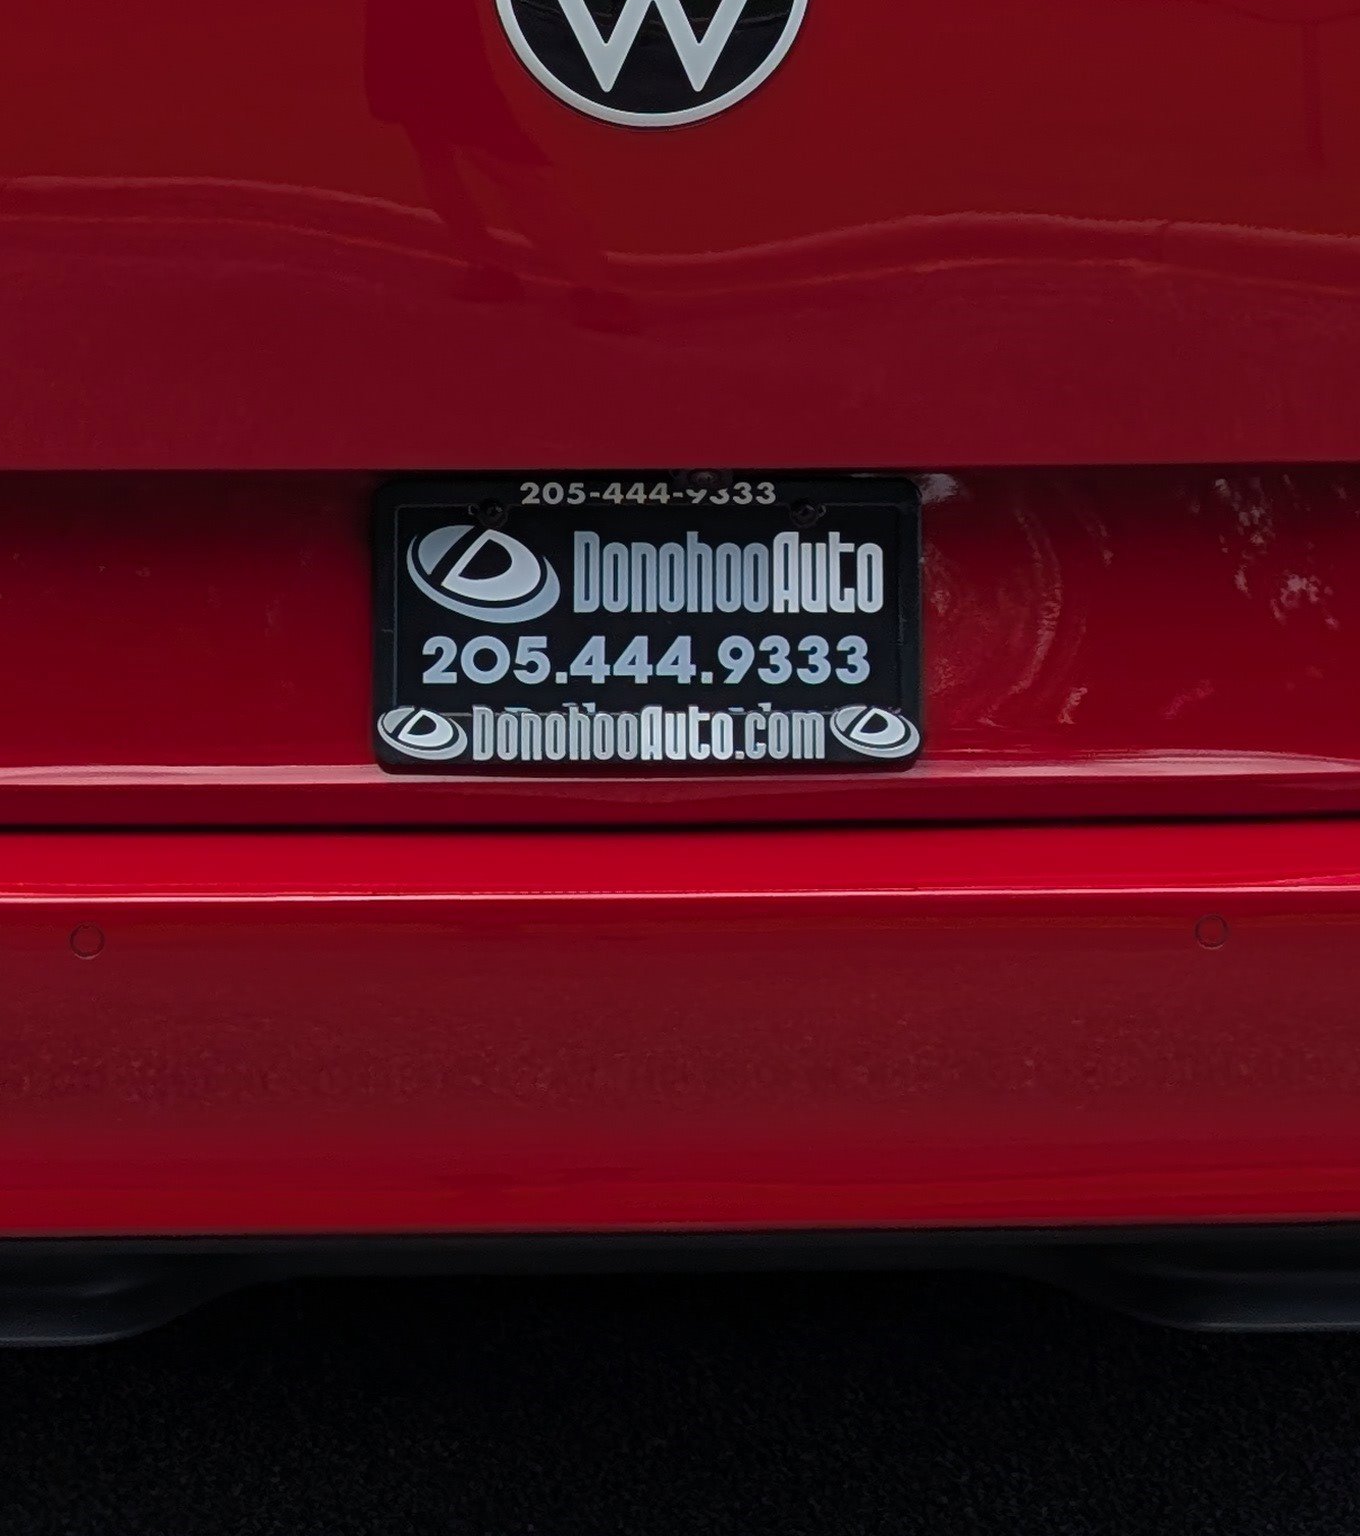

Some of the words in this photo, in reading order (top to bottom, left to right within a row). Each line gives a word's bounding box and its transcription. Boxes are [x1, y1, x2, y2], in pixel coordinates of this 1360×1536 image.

[573, 530, 884, 613] DonohooAuto
[421, 635, 871, 685] 205.444.9333
[472, 705, 826, 761] DonohooAuto.com
